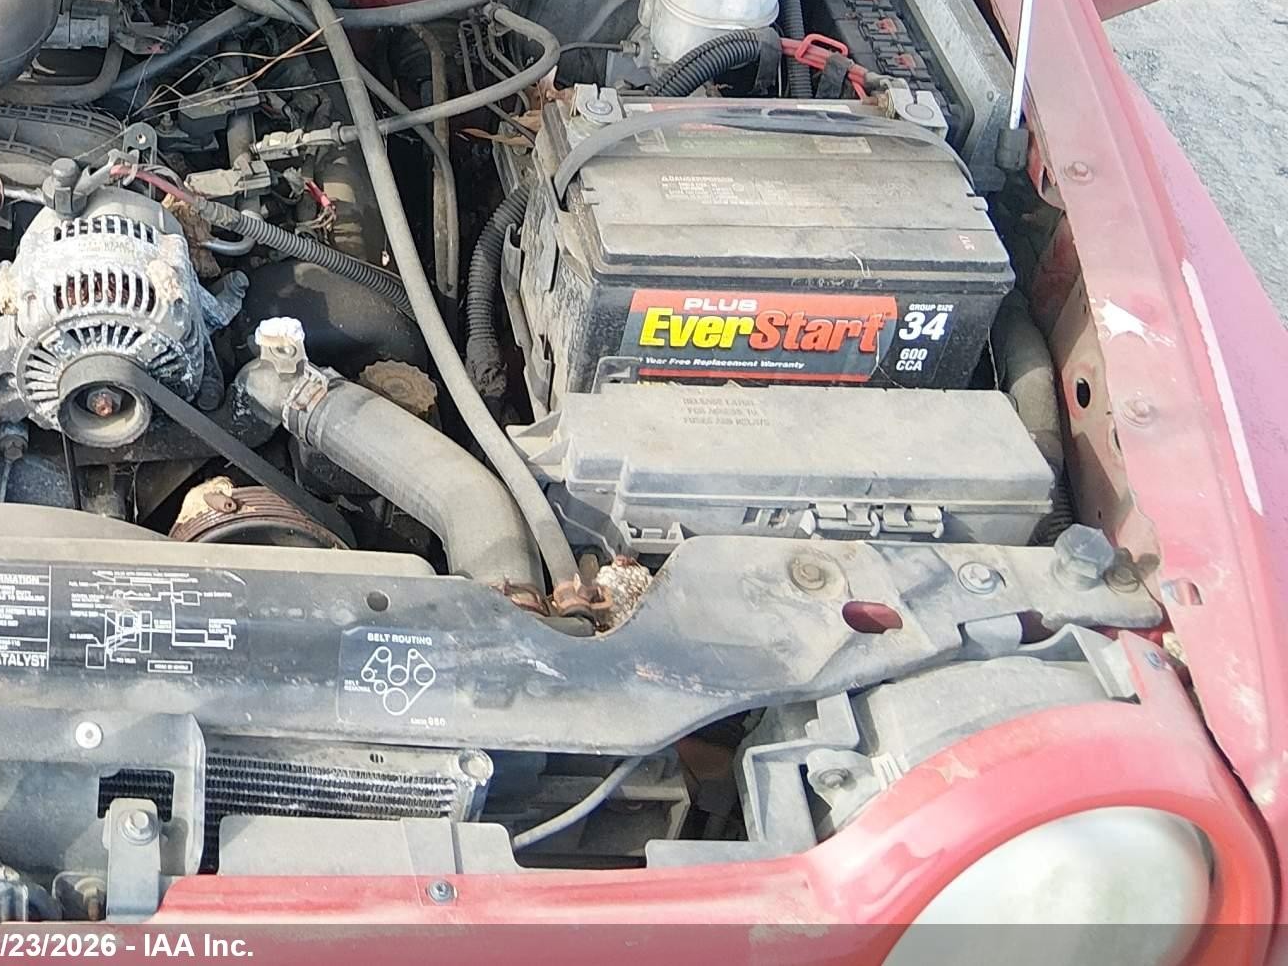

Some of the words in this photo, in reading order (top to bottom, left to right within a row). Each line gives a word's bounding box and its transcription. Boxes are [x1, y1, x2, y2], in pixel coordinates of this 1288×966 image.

[683, 297, 759, 312] PLUS
[909, 303, 936, 311] GROUP
[937, 304, 954, 312] SIZE
[638, 307, 886, 352] EverStart
[899, 311, 949, 341] 34
[900, 347, 928, 360] 600
[645, 356, 667, 365] Year
[669, 357, 691, 365] Free
[693, 358, 758, 368] Replacement
[760, 360, 806, 369] Warranty
[896, 360, 923, 371] CCA
[367, 632, 390, 643] BELT
[391, 634, 432, 645] ROUTING
